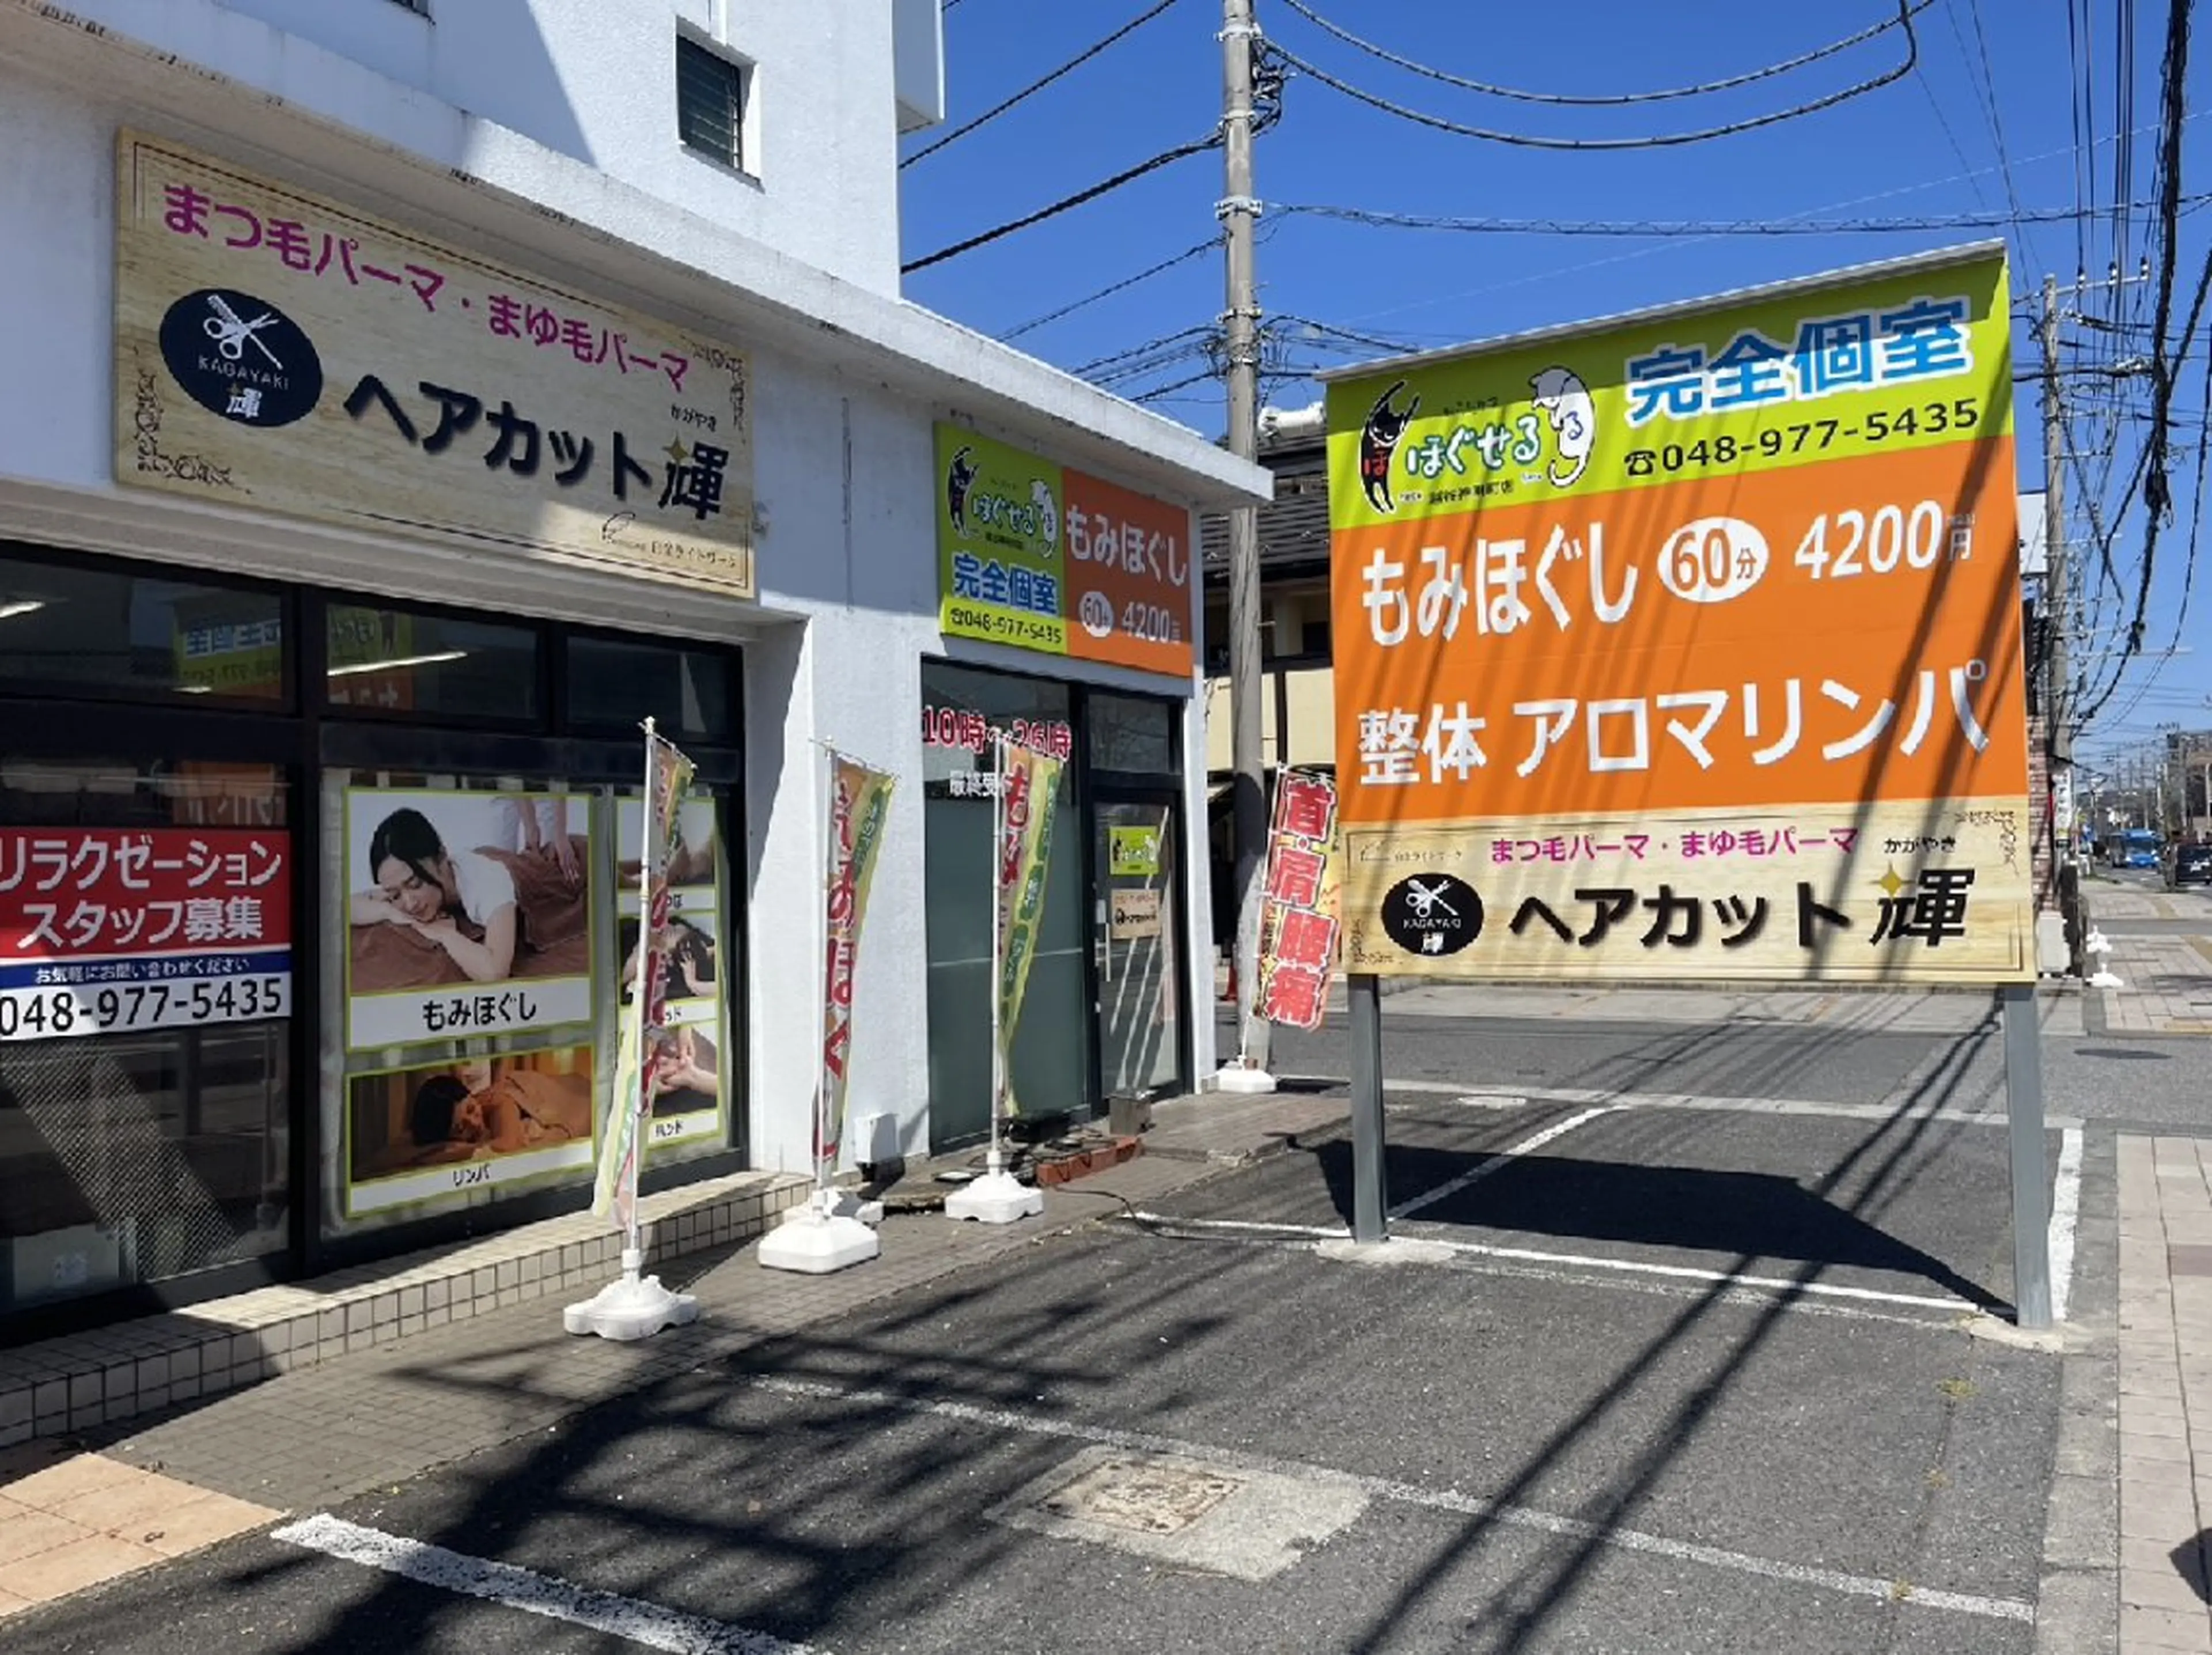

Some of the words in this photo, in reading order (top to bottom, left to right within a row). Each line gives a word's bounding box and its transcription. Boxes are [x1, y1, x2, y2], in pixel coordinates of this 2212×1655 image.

[198, 354, 289, 390] KAGAYAKI
[1624, 297, 1970, 426] 完全個室
[344, 374, 729, 520] ヘアカット輝
[1663, 397, 1979, 472] 048-977-5435
[1067, 505, 1186, 586] もみほぐし
[1362, 521, 1637, 646] もみほぐし
[1794, 498, 1975, 579] 4200円
[953, 551, 1058, 616] 完全個室
[1358, 702, 1486, 786] 整体
[1513, 660, 1988, 778] アロマリンパ
[0, 834, 282, 891] リラクゼーション
[1492, 828, 1858, 864] まつ毛パーマ・まゆ毛パーマ
[1884, 835, 1956, 855] かがやき
[17, 896, 263, 950] スタッフ募集
[1509, 867, 1975, 949] ヘアカット輝
[36, 959, 249, 984] お気軽にお問い合わせください
[0, 978, 282, 1036] 048-977-5435
[423, 992, 537, 1032] もみほぐし
